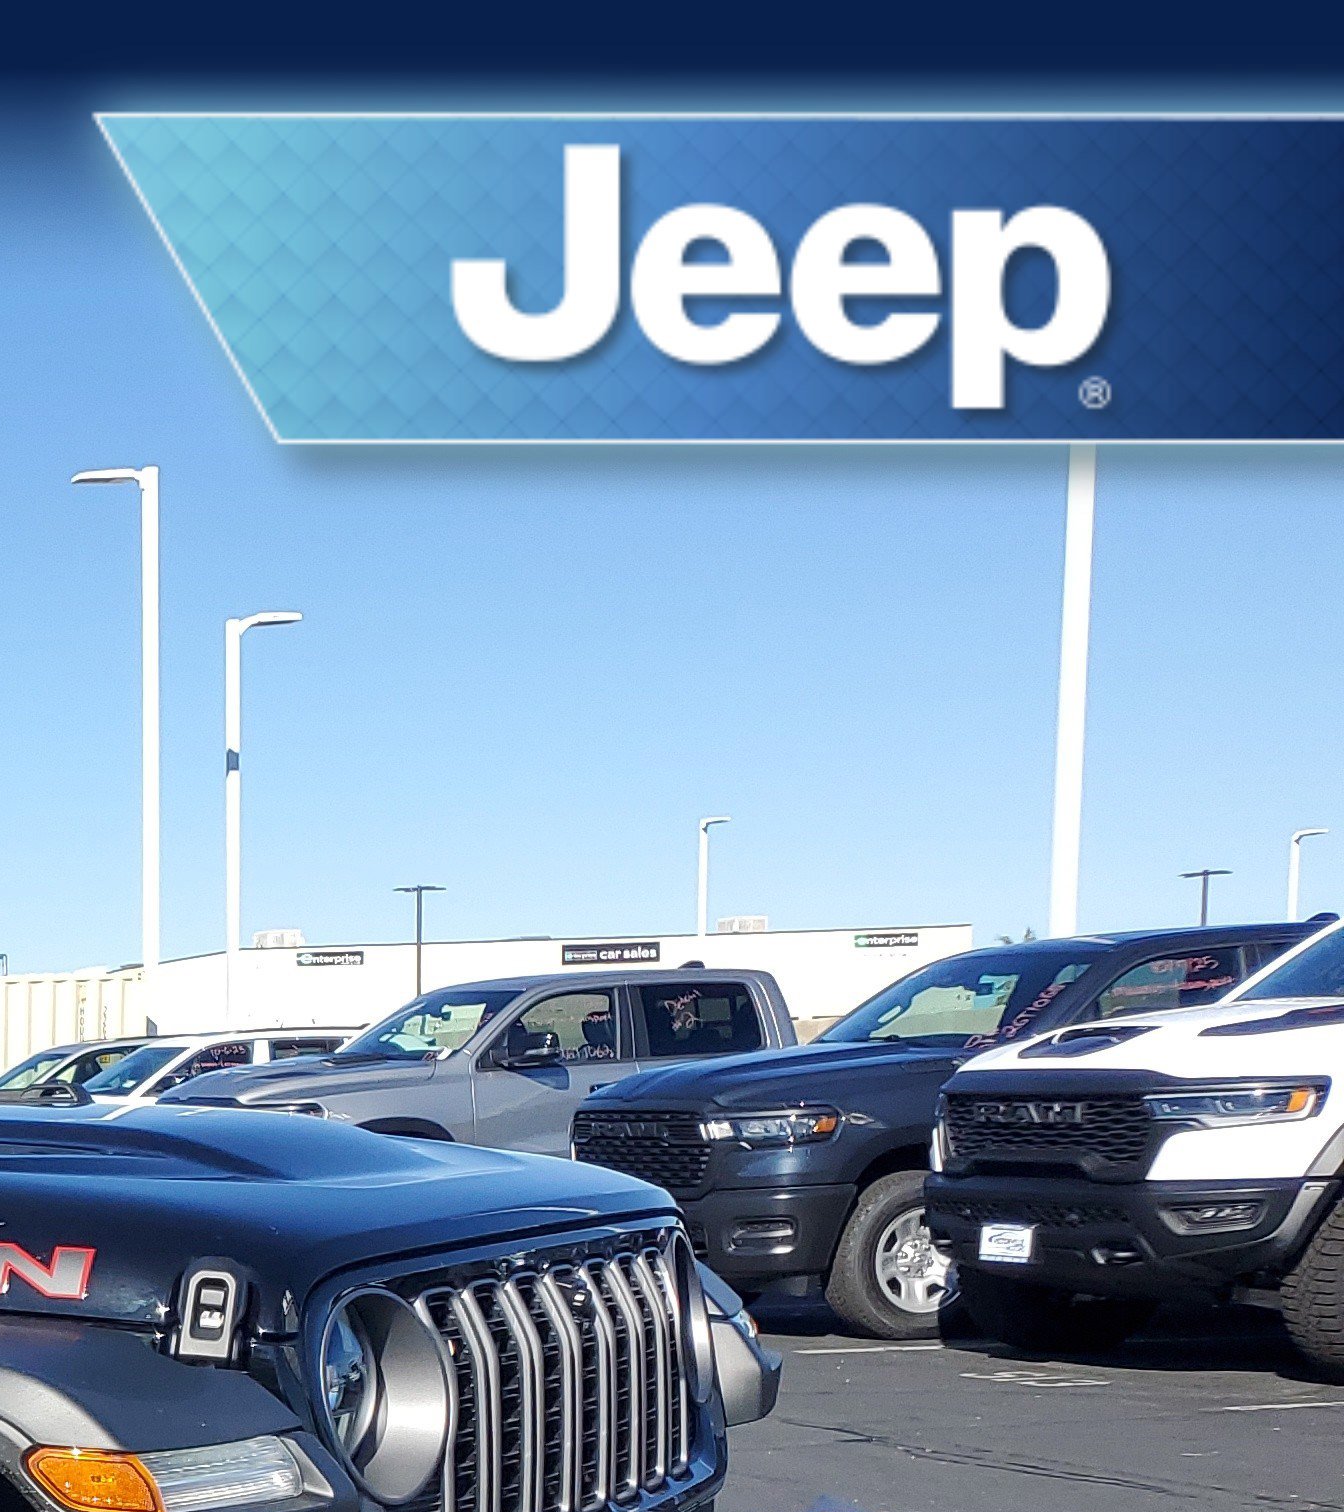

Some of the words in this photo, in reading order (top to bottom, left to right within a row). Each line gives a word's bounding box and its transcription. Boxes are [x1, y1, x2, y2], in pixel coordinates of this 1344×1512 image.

[296, 953, 362, 965] enterprise
[599, 949, 621, 960] car
[623, 946, 657, 959] sales
[974, 1102, 1083, 1123] RAM
